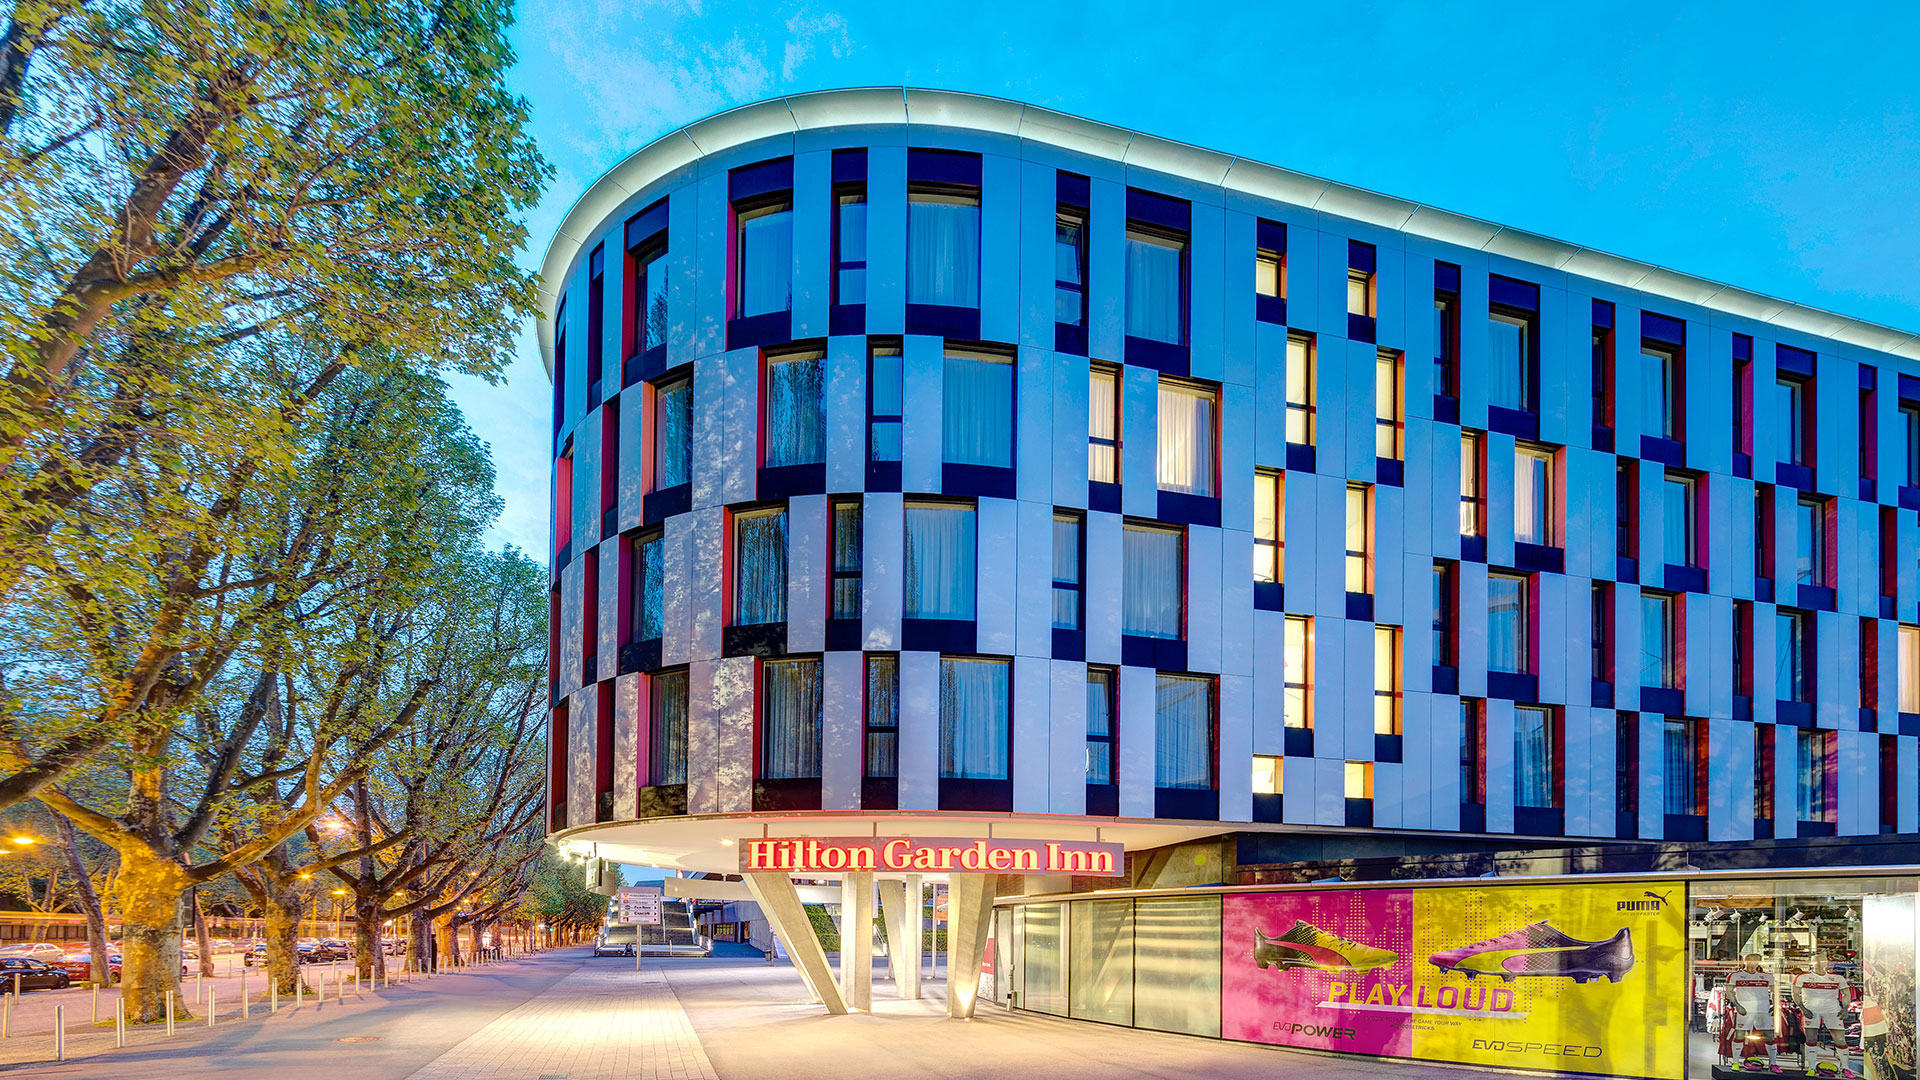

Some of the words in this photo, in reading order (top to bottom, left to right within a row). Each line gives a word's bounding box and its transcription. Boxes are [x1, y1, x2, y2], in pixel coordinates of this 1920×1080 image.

[747, 840, 878, 870] Hilton
[882, 839, 1041, 871] Garden
[1045, 842, 1116, 873] Inn
[1616, 900, 1660, 911] PUMA
[1328, 981, 1408, 1007] PLAY
[1416, 985, 1515, 1012] LOUD
[1472, 1039, 1603, 1058] EVOSPEED
